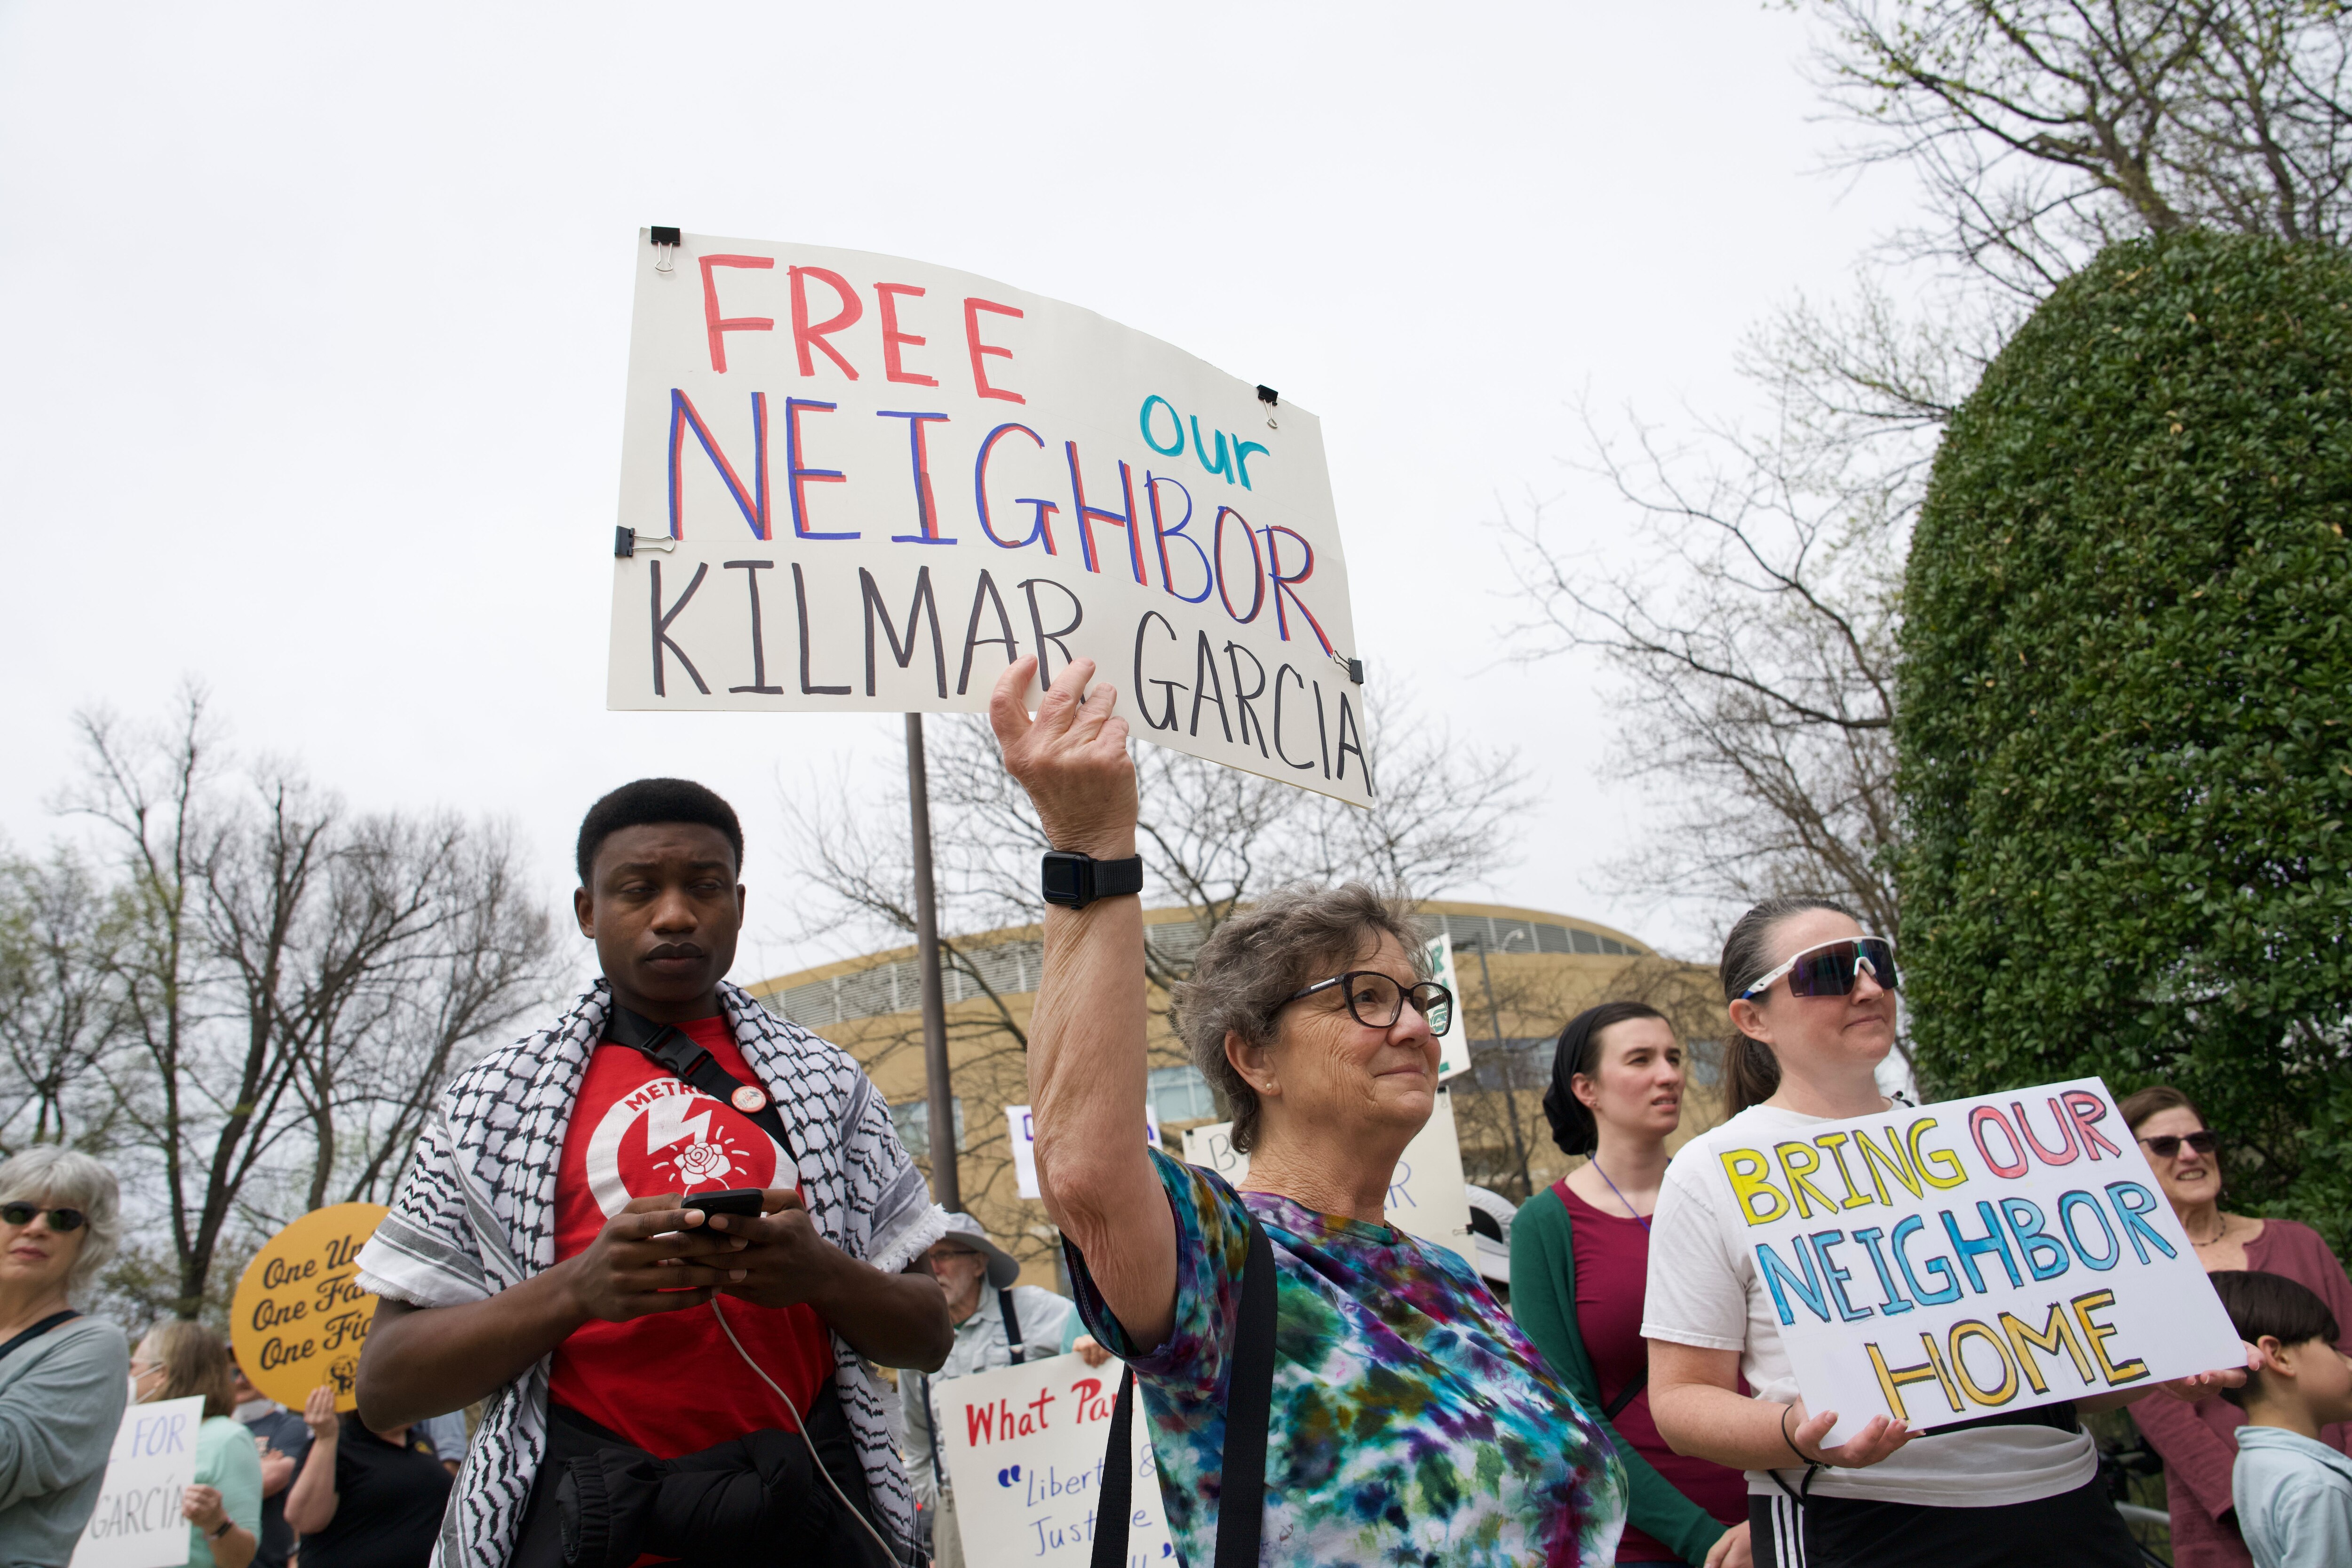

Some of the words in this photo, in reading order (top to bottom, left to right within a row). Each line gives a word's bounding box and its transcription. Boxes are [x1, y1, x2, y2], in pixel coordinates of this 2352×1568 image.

[699, 255, 1026, 405] FREE
[1139, 394, 1270, 491] our
[668, 388, 1335, 658] NEIGHBOR
[650, 559, 1087, 705] KILMAR
[1134, 610, 1373, 798] GARCIA
[1719, 1117, 1969, 1226] BRING
[1968, 1090, 2122, 1179] OUR
[253, 1298, 309, 1331] One
[314, 1272, 367, 1312] Fa
[263, 1257, 318, 1289] One
[326, 1229, 376, 1269] Un
[1755, 1180, 2177, 1326] NEIGHBOR
[260, 1337, 317, 1370] One
[1864, 1288, 2151, 1422] HOME
[131, 1413, 186, 1458] FOR
[966, 1387, 1056, 1447] What
[1029, 1509, 1152, 1556] Juste
